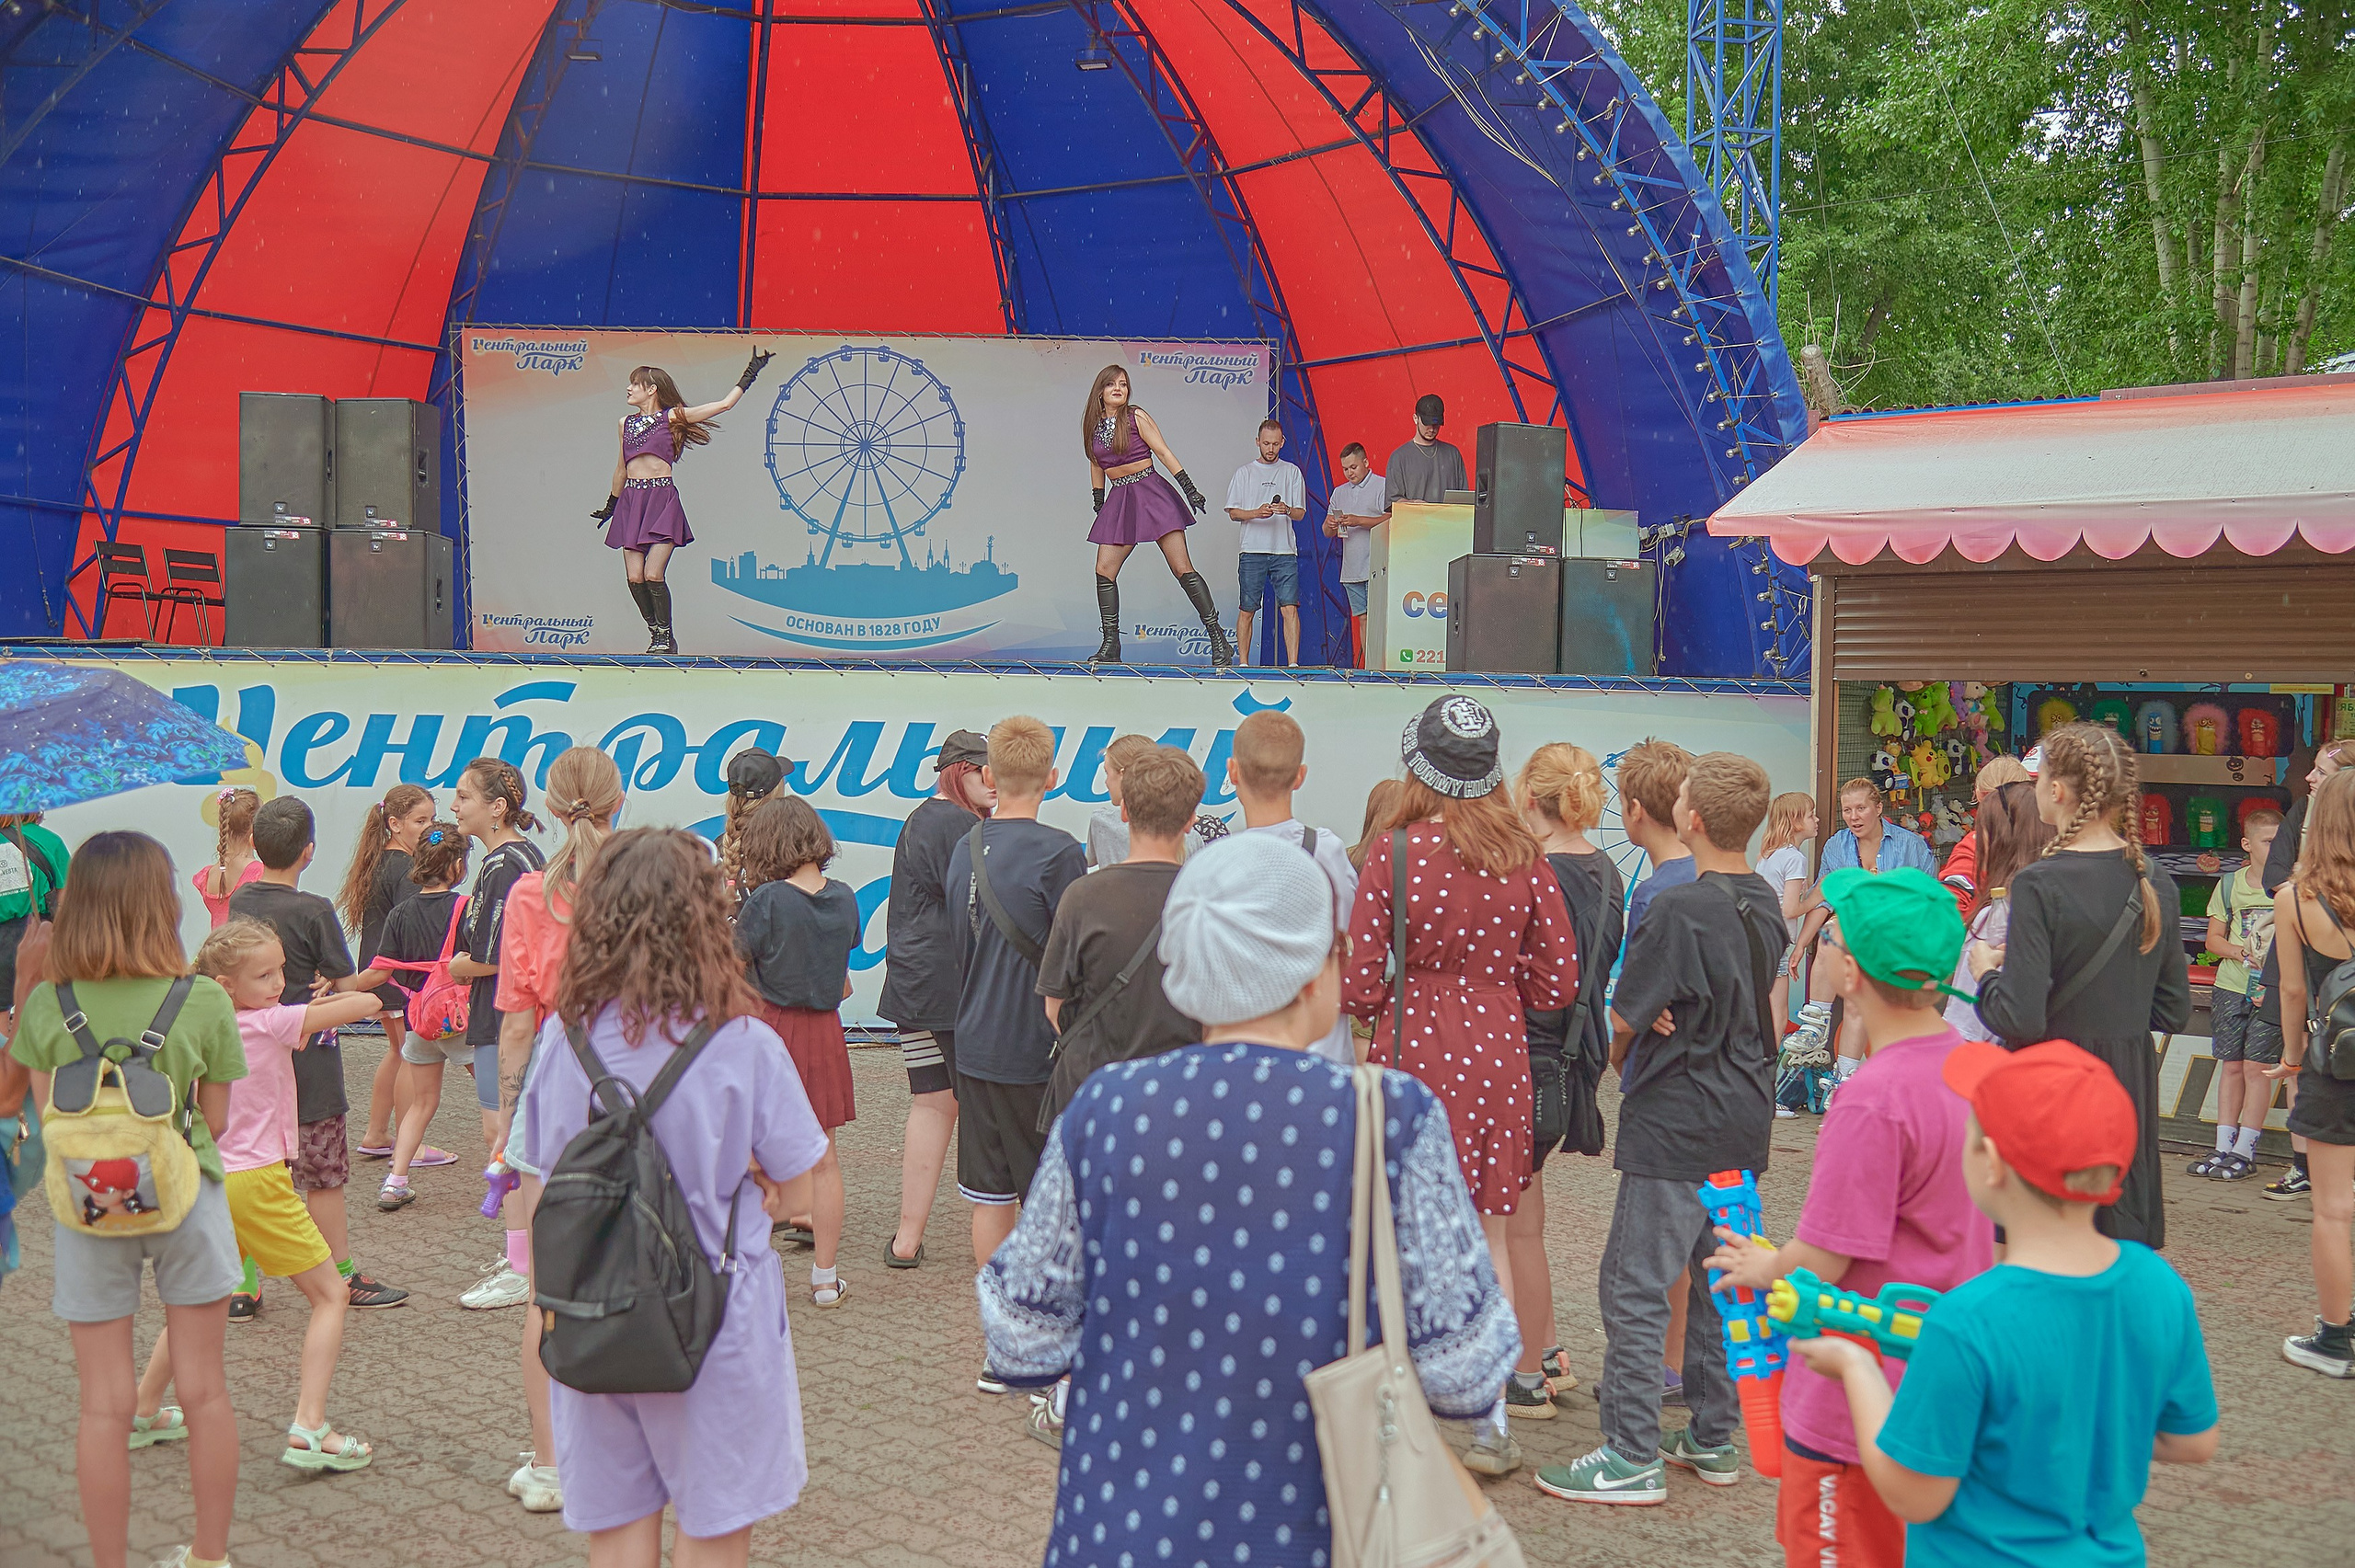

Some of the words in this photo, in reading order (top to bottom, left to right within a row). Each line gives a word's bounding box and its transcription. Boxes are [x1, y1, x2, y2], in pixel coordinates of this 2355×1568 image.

[473, 338, 589, 356] Центральный
[516, 355, 583, 377] Парк
[1140, 352, 1258, 370] Центральный
[1184, 370, 1253, 391] Парк
[482, 613, 594, 631] Центральный
[786, 615, 854, 636] ОСНОВАН
[856, 624, 867, 636] В
[868, 624, 902, 637] 1828
[903, 616, 941, 635] ГОДУ
[524, 630, 590, 650] Парк
[1416, 649, 1446, 664] 221
[1407, 750, 1465, 797] TOMMY
[1819, 1473, 1838, 1542] VACAY
